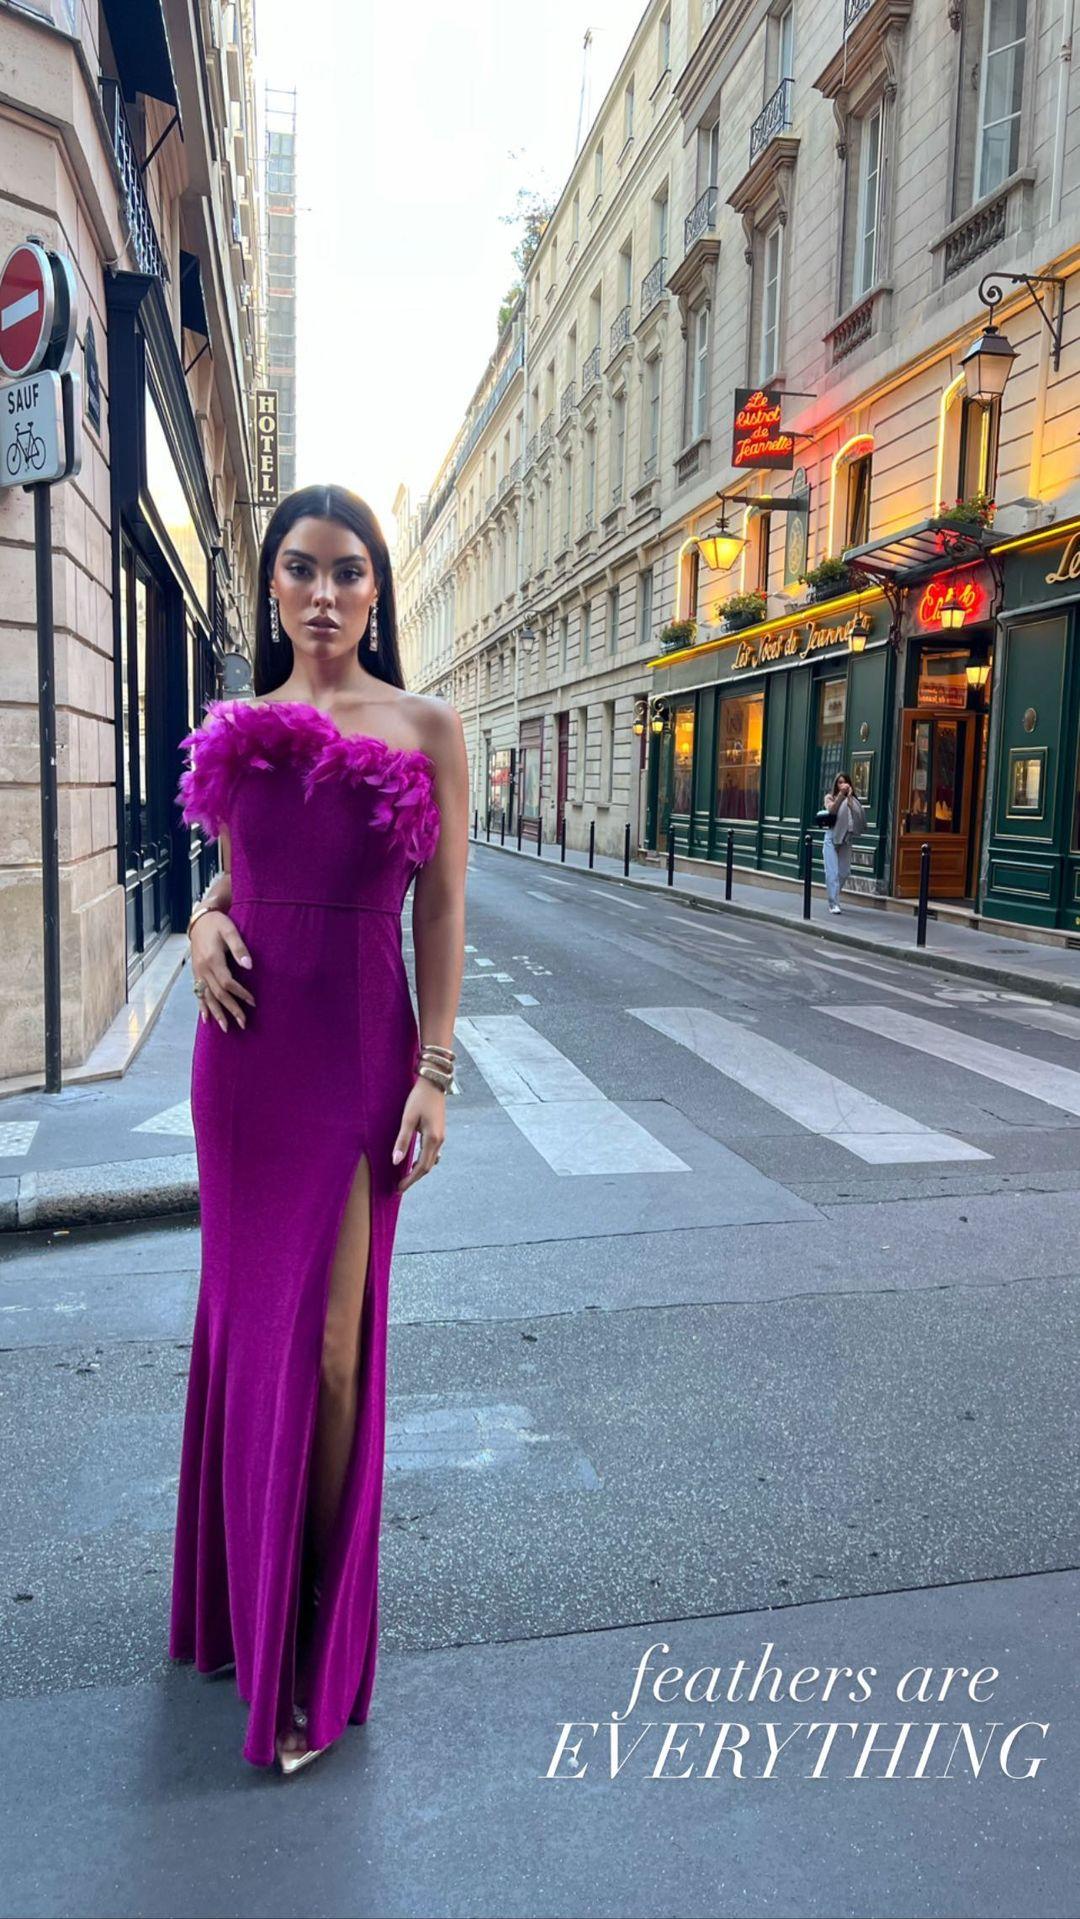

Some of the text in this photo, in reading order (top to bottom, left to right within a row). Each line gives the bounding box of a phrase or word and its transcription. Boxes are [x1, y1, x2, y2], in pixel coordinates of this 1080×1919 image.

[8, 382, 39, 415] SAUF
[745, 391, 768, 410] Le
[258, 395, 276, 492] HOTEL
[751, 425, 769, 439] de
